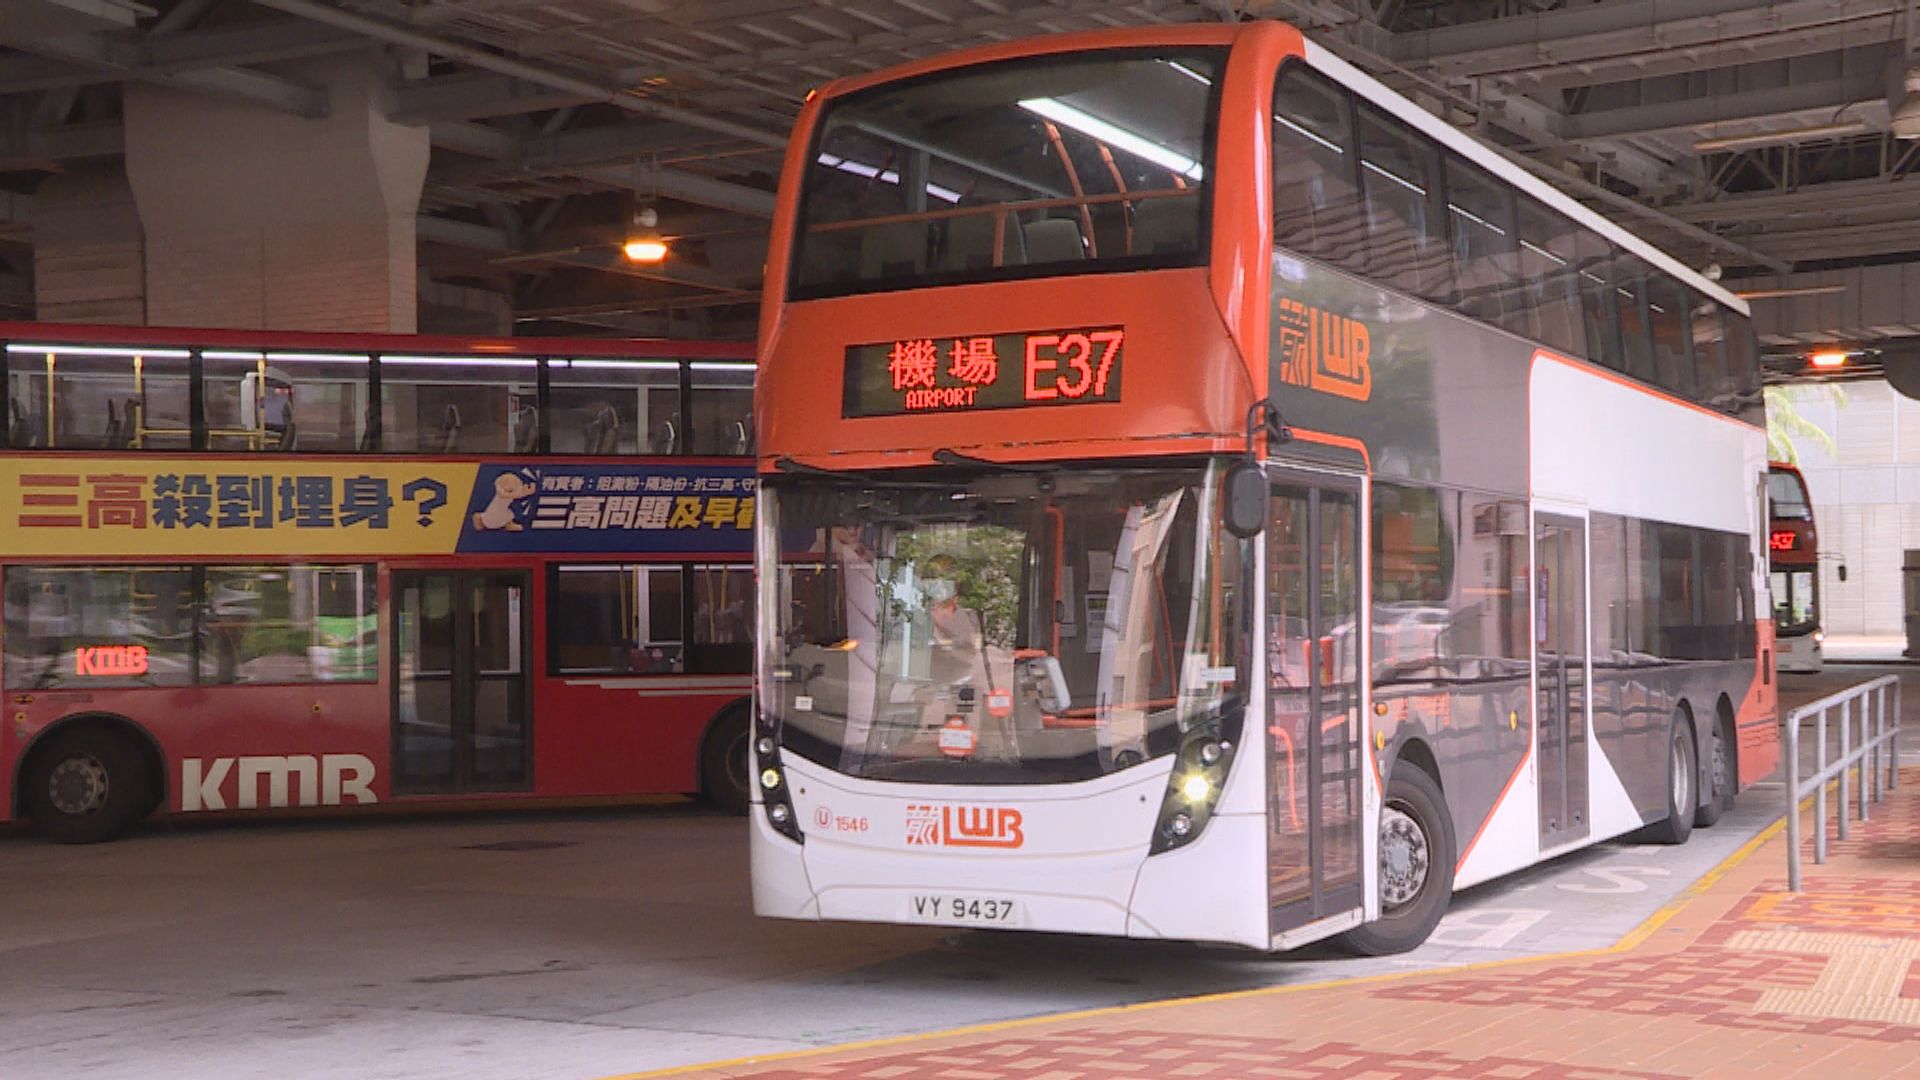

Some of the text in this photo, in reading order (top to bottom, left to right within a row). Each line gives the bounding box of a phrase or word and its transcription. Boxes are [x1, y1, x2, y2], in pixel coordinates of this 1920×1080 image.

[888, 338, 999, 391] 機場
[1024, 330, 1124, 400] E37
[905, 386, 977, 409] AIRPORT
[835, 816, 869, 832] 1546
[914, 896, 1013, 920] VY 9437
